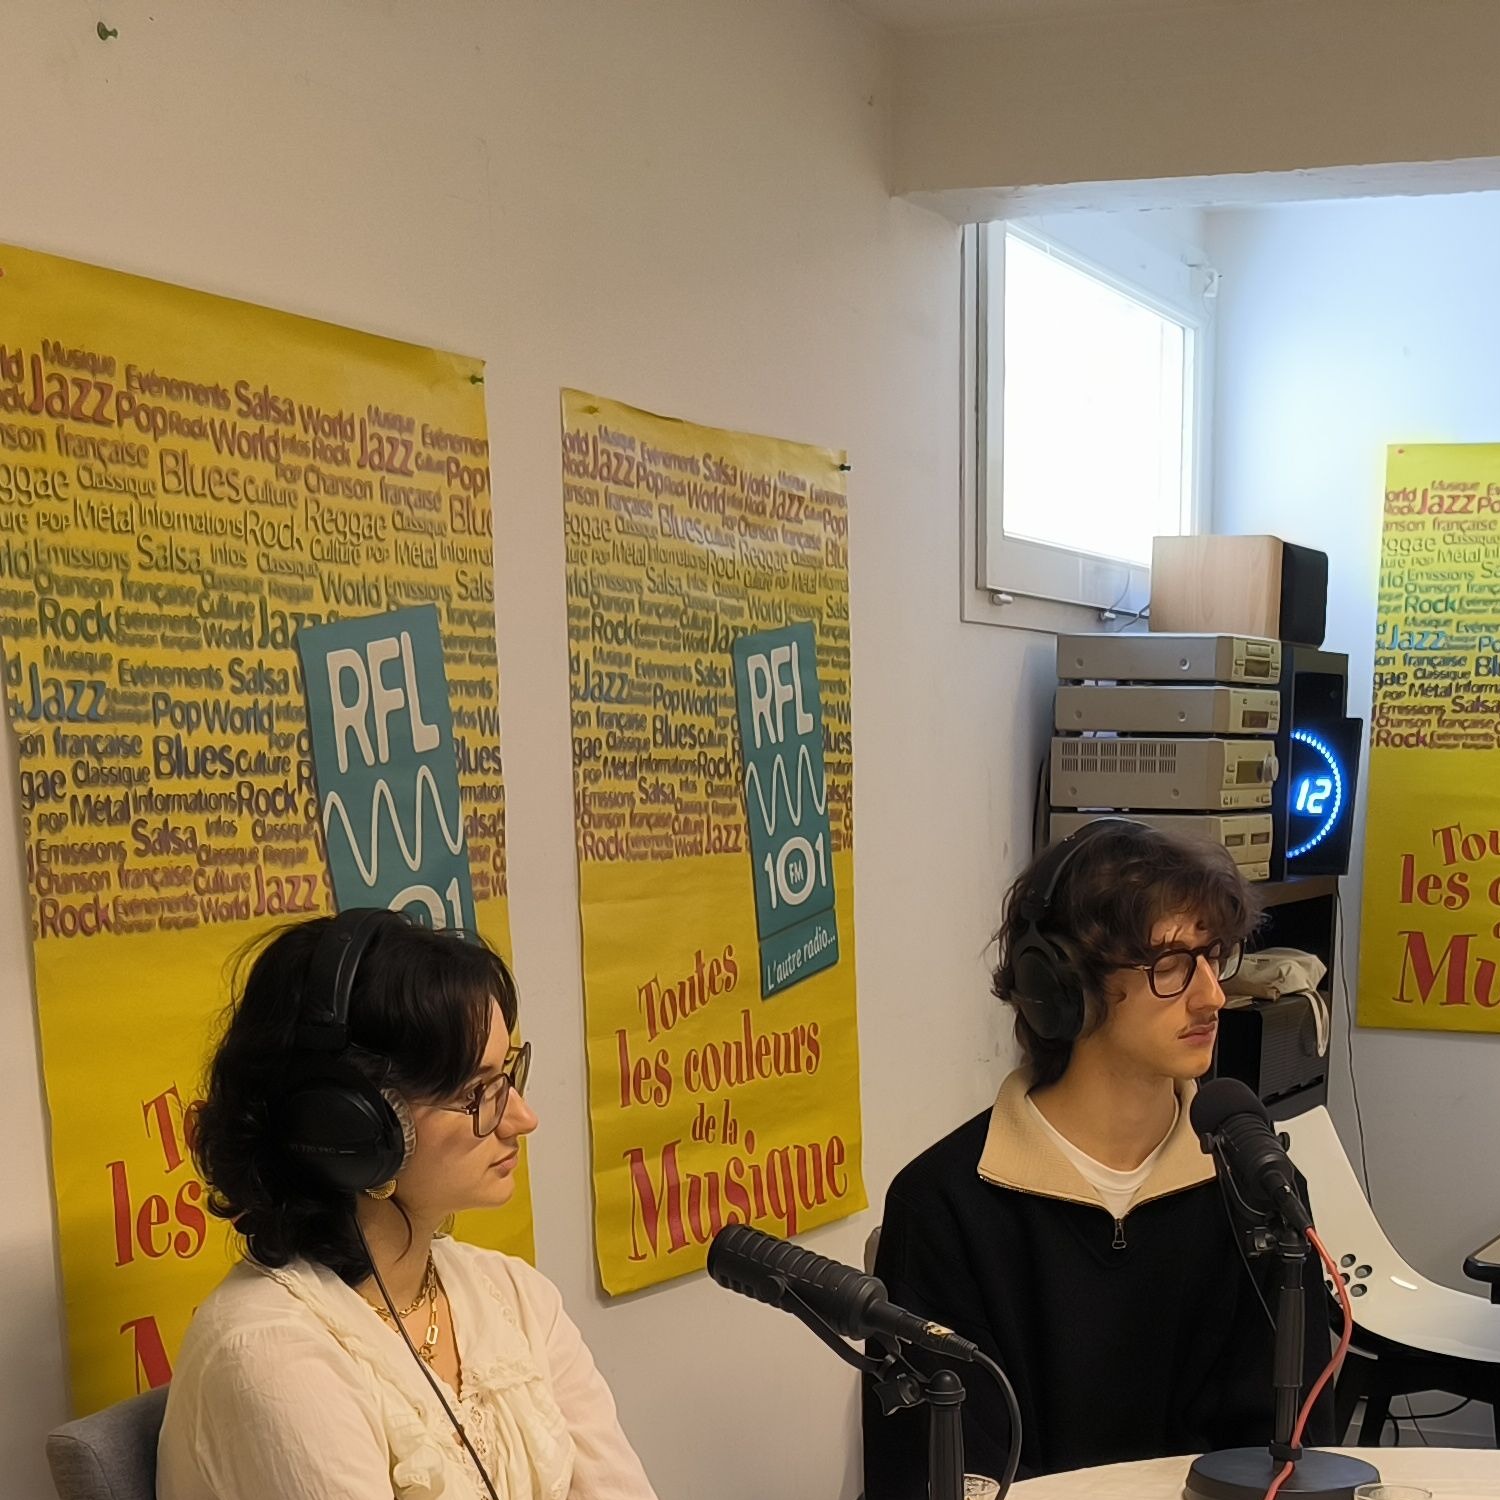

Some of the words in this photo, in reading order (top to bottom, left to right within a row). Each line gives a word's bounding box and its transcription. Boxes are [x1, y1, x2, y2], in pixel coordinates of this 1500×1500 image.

[28, 353, 115, 427] Jazz
[116, 391, 168, 443] Pop
[209, 416, 282, 464] World
[234, 380, 296, 426] Salsa
[299, 404, 355, 443] World
[357, 417, 414, 477] Jazz
[159, 448, 242, 502] Blues
[1417, 488, 1477, 515] Jazz
[136, 532, 201, 573] Salsa
[38, 597, 115, 644] Rock
[1405, 595, 1456, 614] Rock
[1386, 624, 1448, 651] Jazz
[26, 662, 107, 723] Jazz
[152, 692, 201, 736] Pop
[201, 699, 275, 736] World
[227, 657, 289, 695] Salsa
[747, 641, 814, 750] RFL
[325, 631, 440, 774] RFL
[1451, 695, 1500, 714] Salsa
[152, 732, 236, 780] Blues
[652, 713, 697, 751] Blues
[1376, 728, 1430, 748] Rock
[236, 779, 298, 819] Rock
[1296, 778, 1333, 815] 12
[131, 818, 198, 858] Salsa
[704, 815, 743, 854] Jazz
[764, 831, 828, 910] 101
[788, 858, 805, 885] FM
[1399, 854, 1471, 911] les
[38, 893, 114, 939] Rock
[253, 863, 320, 916] Jazz
[766, 943, 804, 990] L'autre
[803, 925, 837, 967] radio...
[638, 944, 738, 1043] Toutes
[615, 1028, 673, 1109] les
[684, 1008, 821, 1094] couleurs
[691, 1102, 716, 1145] de
[721, 1099, 739, 1146] la
[105, 1160, 208, 1268] les
[622, 1130, 849, 1262] Musique
